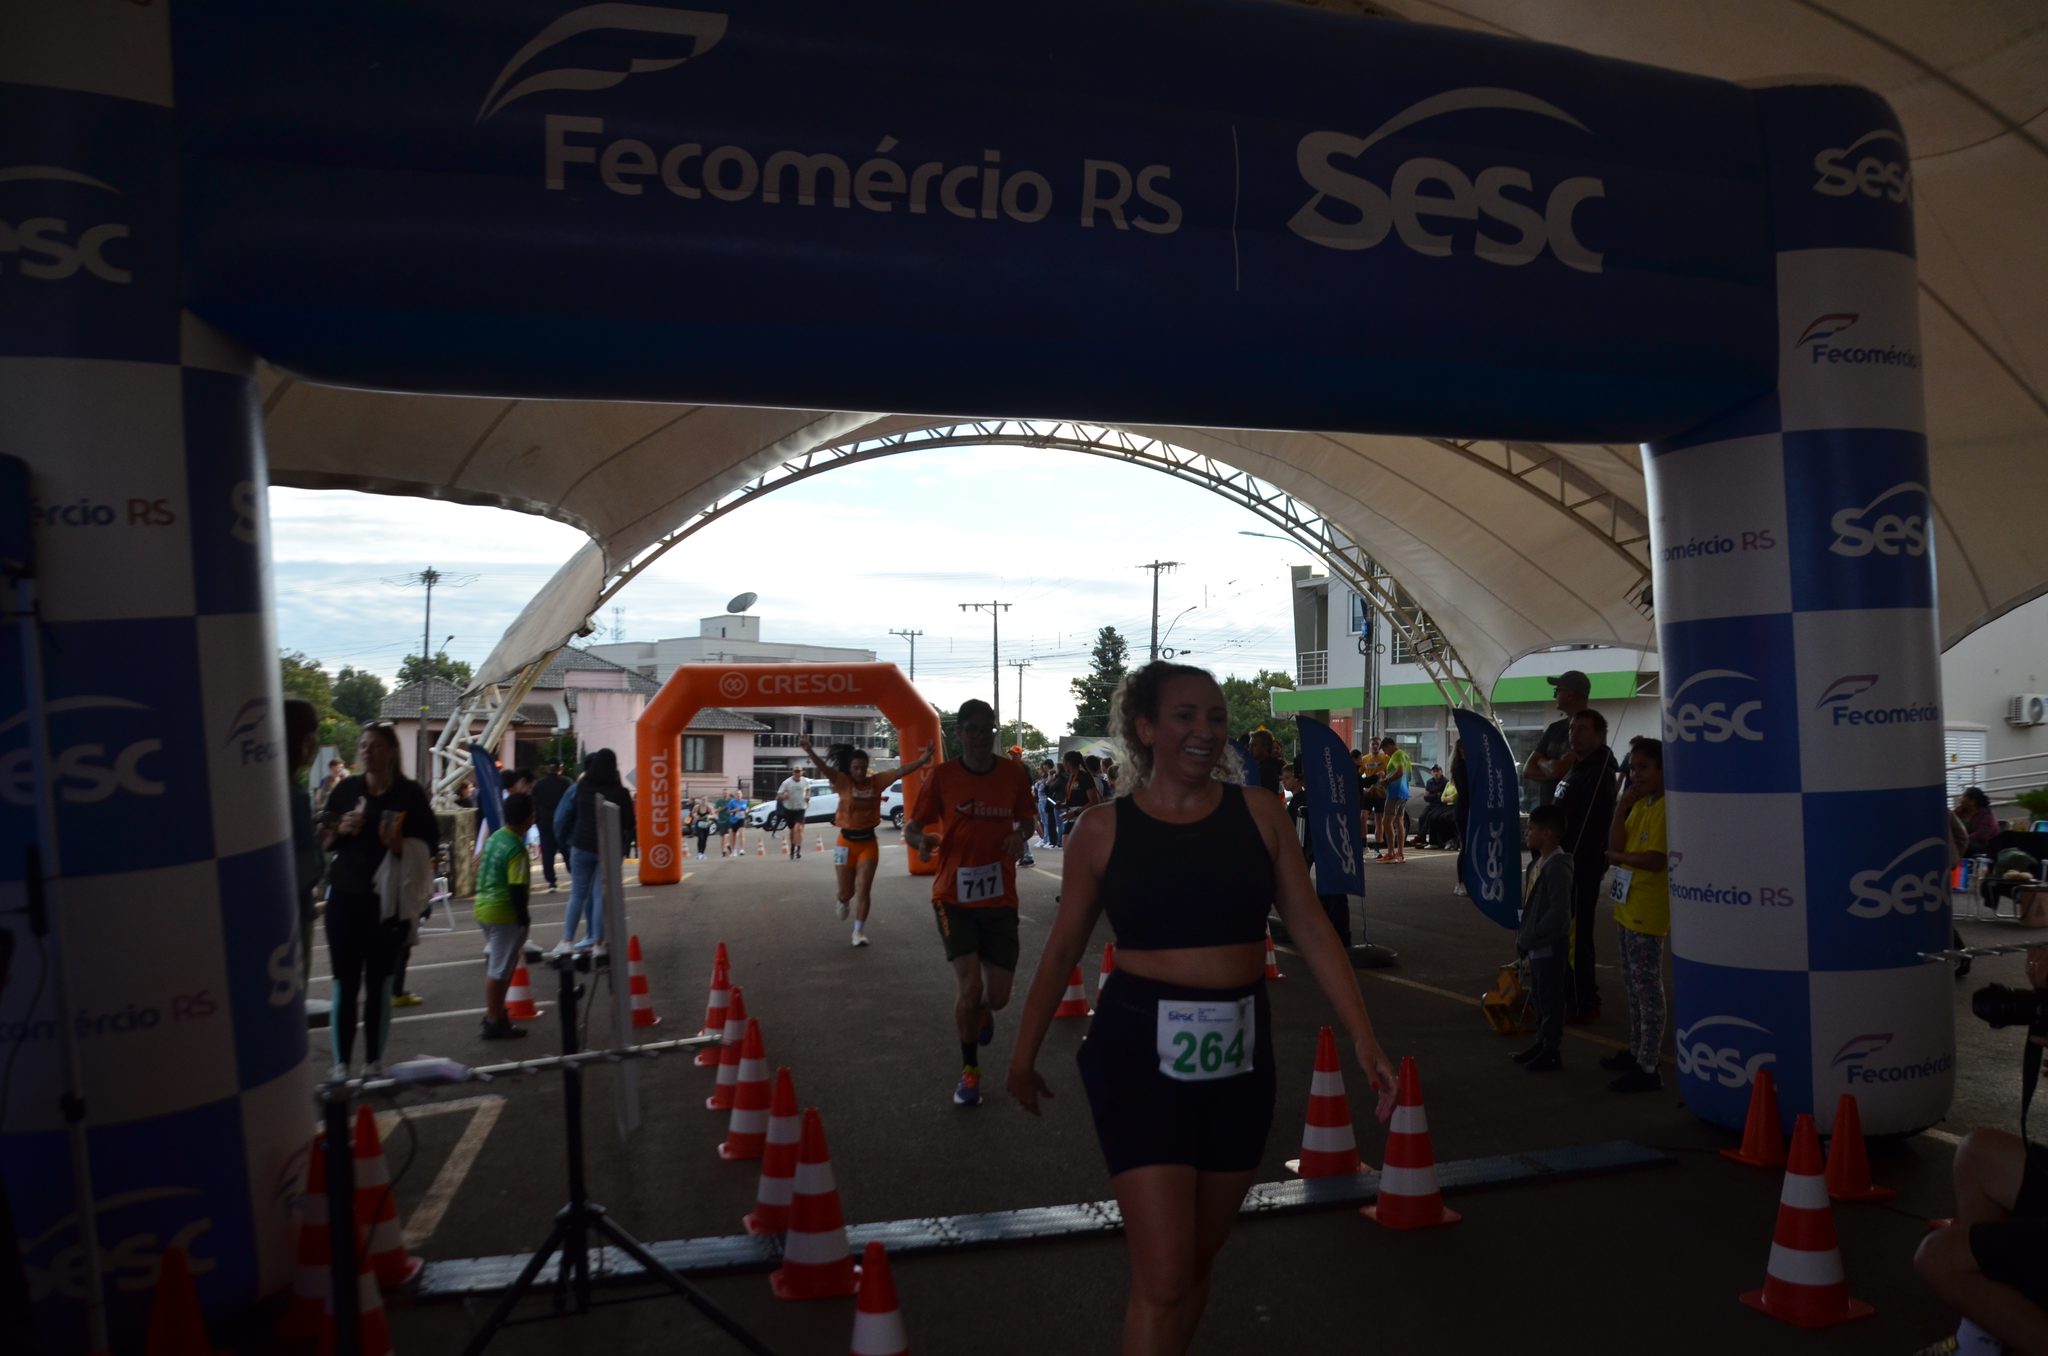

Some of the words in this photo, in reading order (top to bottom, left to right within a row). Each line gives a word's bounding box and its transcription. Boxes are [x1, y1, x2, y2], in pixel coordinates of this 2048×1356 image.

[544, 113, 1053, 223] Fecomércio
[1079, 158, 1184, 235] RS
[1287, 131, 1605, 273] Sesc
[127, 498, 176, 527] RS
[1663, 534, 1734, 562] omércio
[1741, 529, 1776, 551] RS
[757, 673, 863, 694] CRESOL
[650, 748, 670, 837] CRESOL
[1336, 812, 1356, 875] Sesc
[1481, 821, 1505, 903] Sesc
[963, 876, 997, 899] 717
[1669, 877, 1752, 906] ecomércio
[1760, 887, 1794, 907] RS
[172, 990, 218, 1021] RS
[1172, 1028, 1245, 1073] 264
